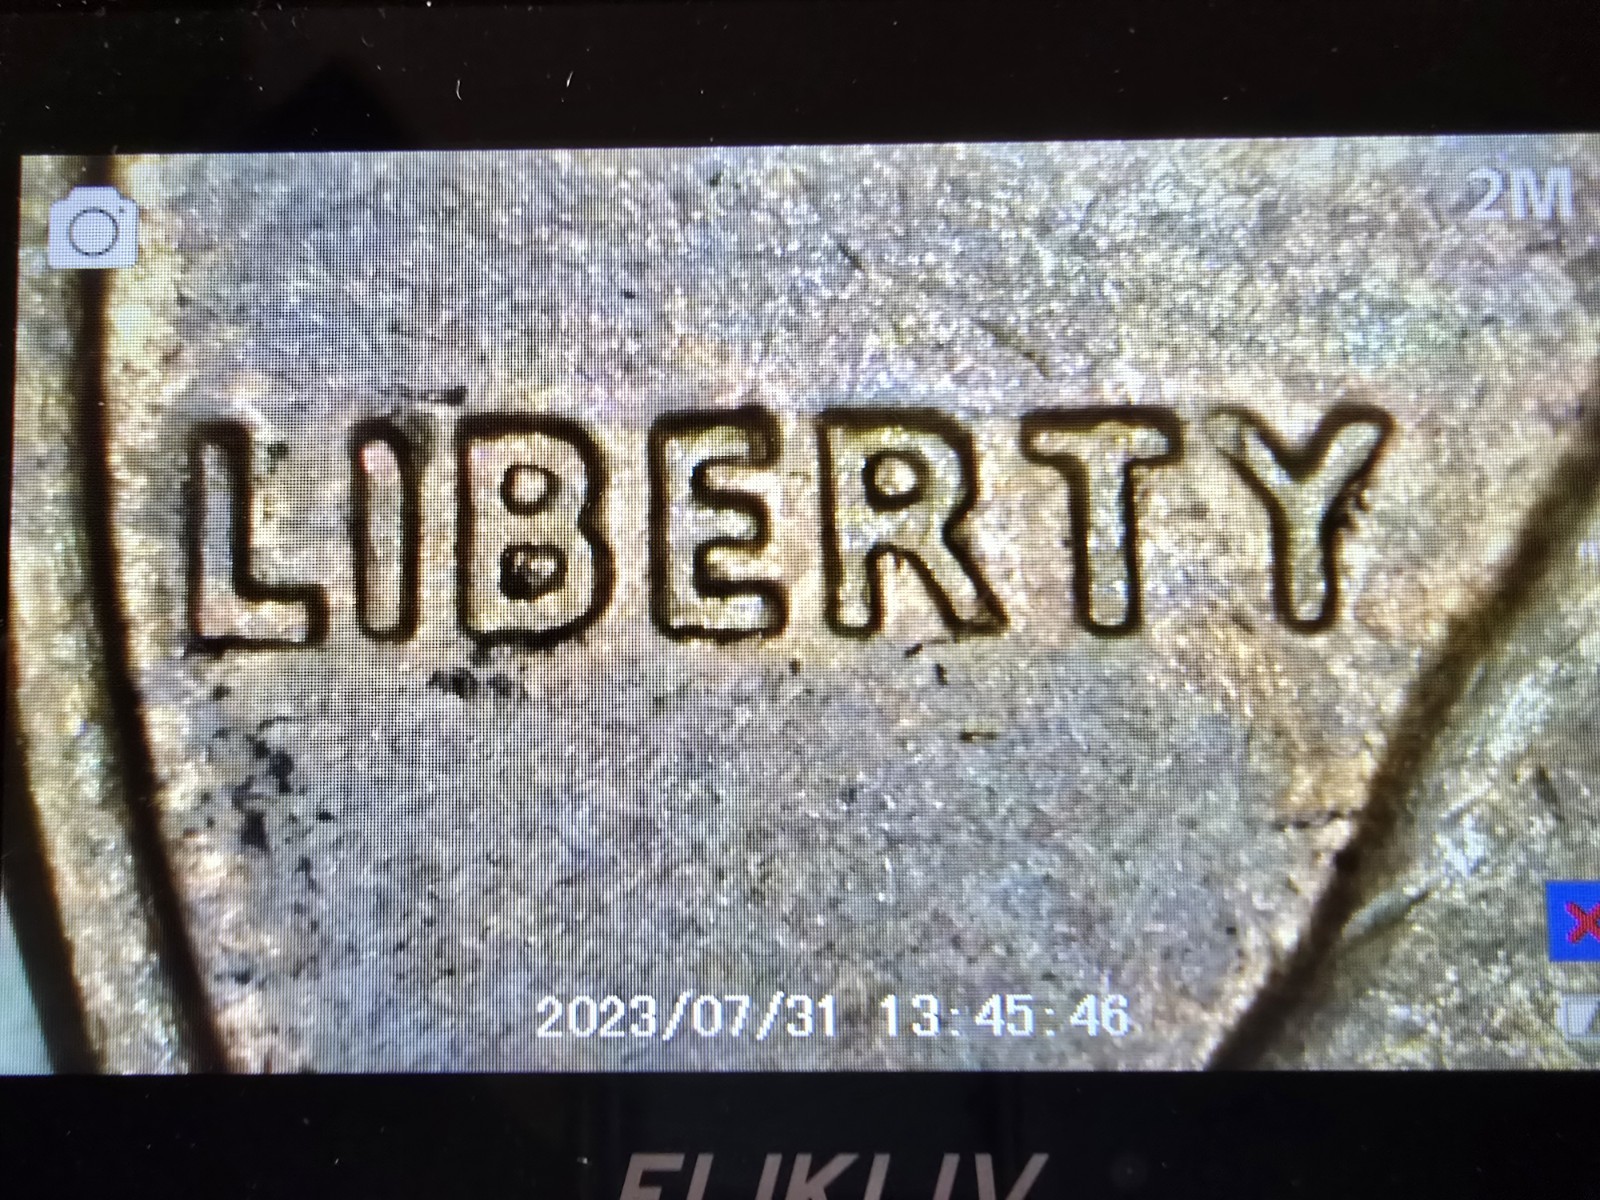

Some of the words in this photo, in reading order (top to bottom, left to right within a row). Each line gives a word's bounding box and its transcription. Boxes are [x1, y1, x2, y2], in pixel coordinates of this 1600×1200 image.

[1466, 165, 1574, 221] 2M
[187, 403, 1394, 650] LIBERTY
[536, 990, 837, 1041] 2023/07/31
[880, 992, 1130, 1039] 13:45:46
